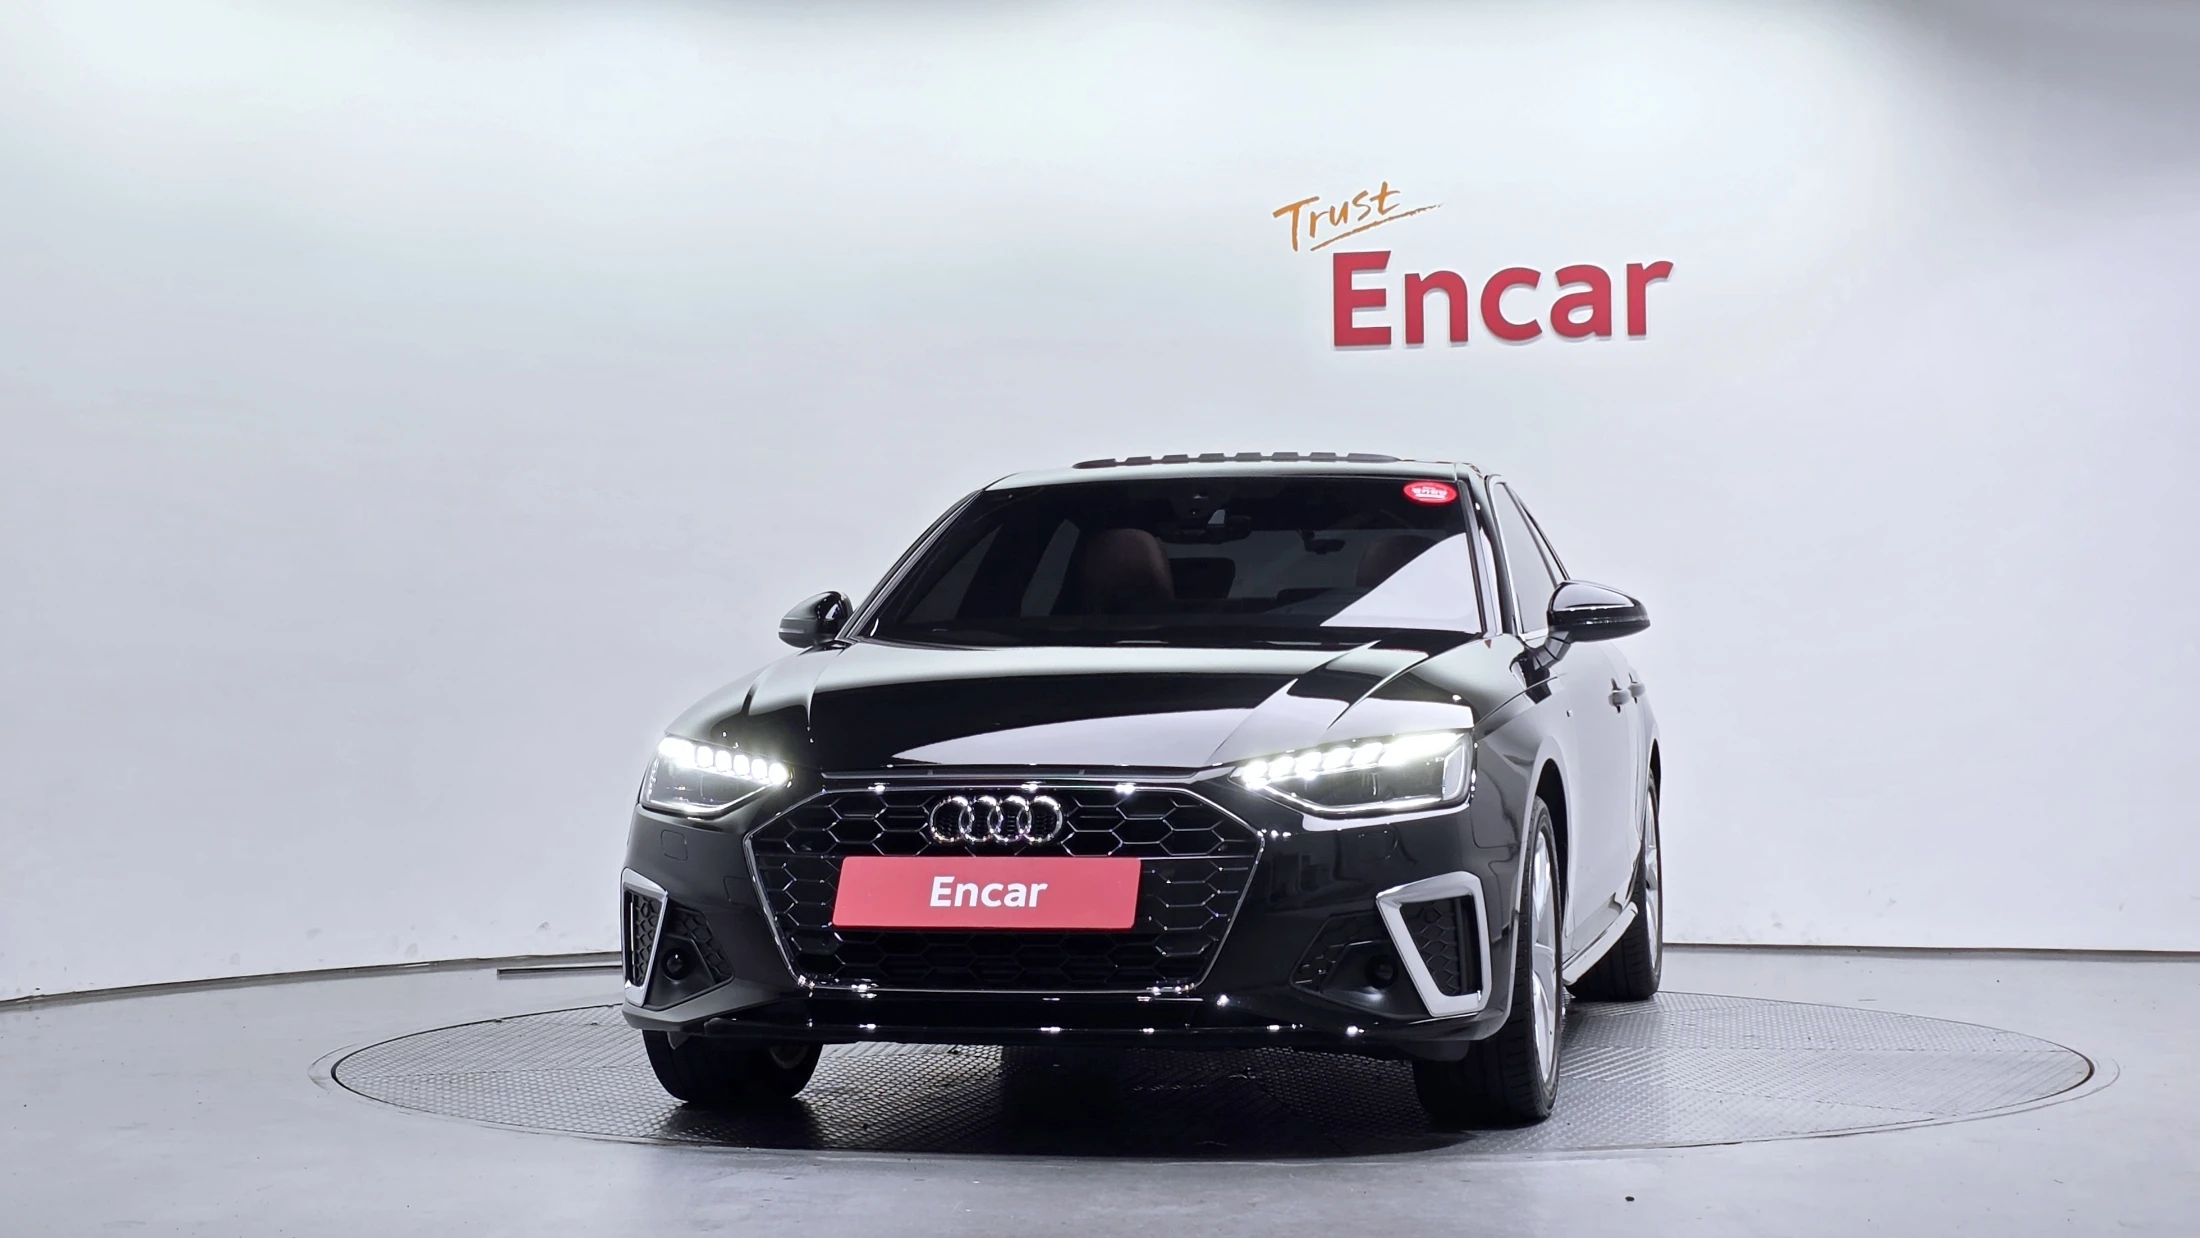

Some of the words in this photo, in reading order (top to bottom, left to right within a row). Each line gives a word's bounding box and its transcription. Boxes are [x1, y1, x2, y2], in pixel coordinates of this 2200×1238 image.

[1273, 181, 1401, 252] Trust
[1332, 250, 1674, 348] Encar
[929, 876, 1048, 908] Encar
